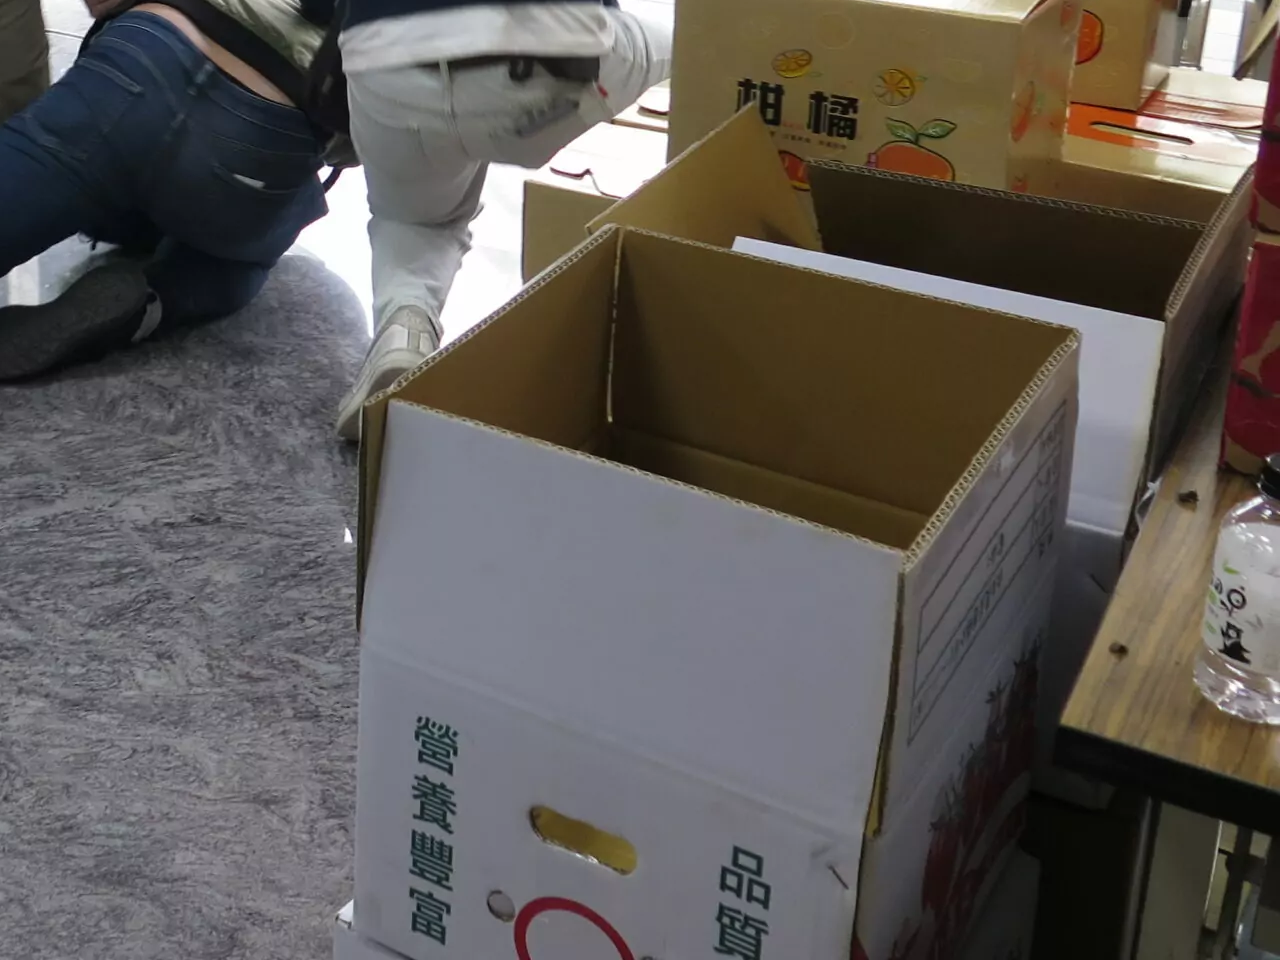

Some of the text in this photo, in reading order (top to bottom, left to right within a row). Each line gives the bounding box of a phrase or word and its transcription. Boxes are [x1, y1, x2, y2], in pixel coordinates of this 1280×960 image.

[409, 716, 459, 946] 營養豐富
[713, 844, 772, 960] 品質
